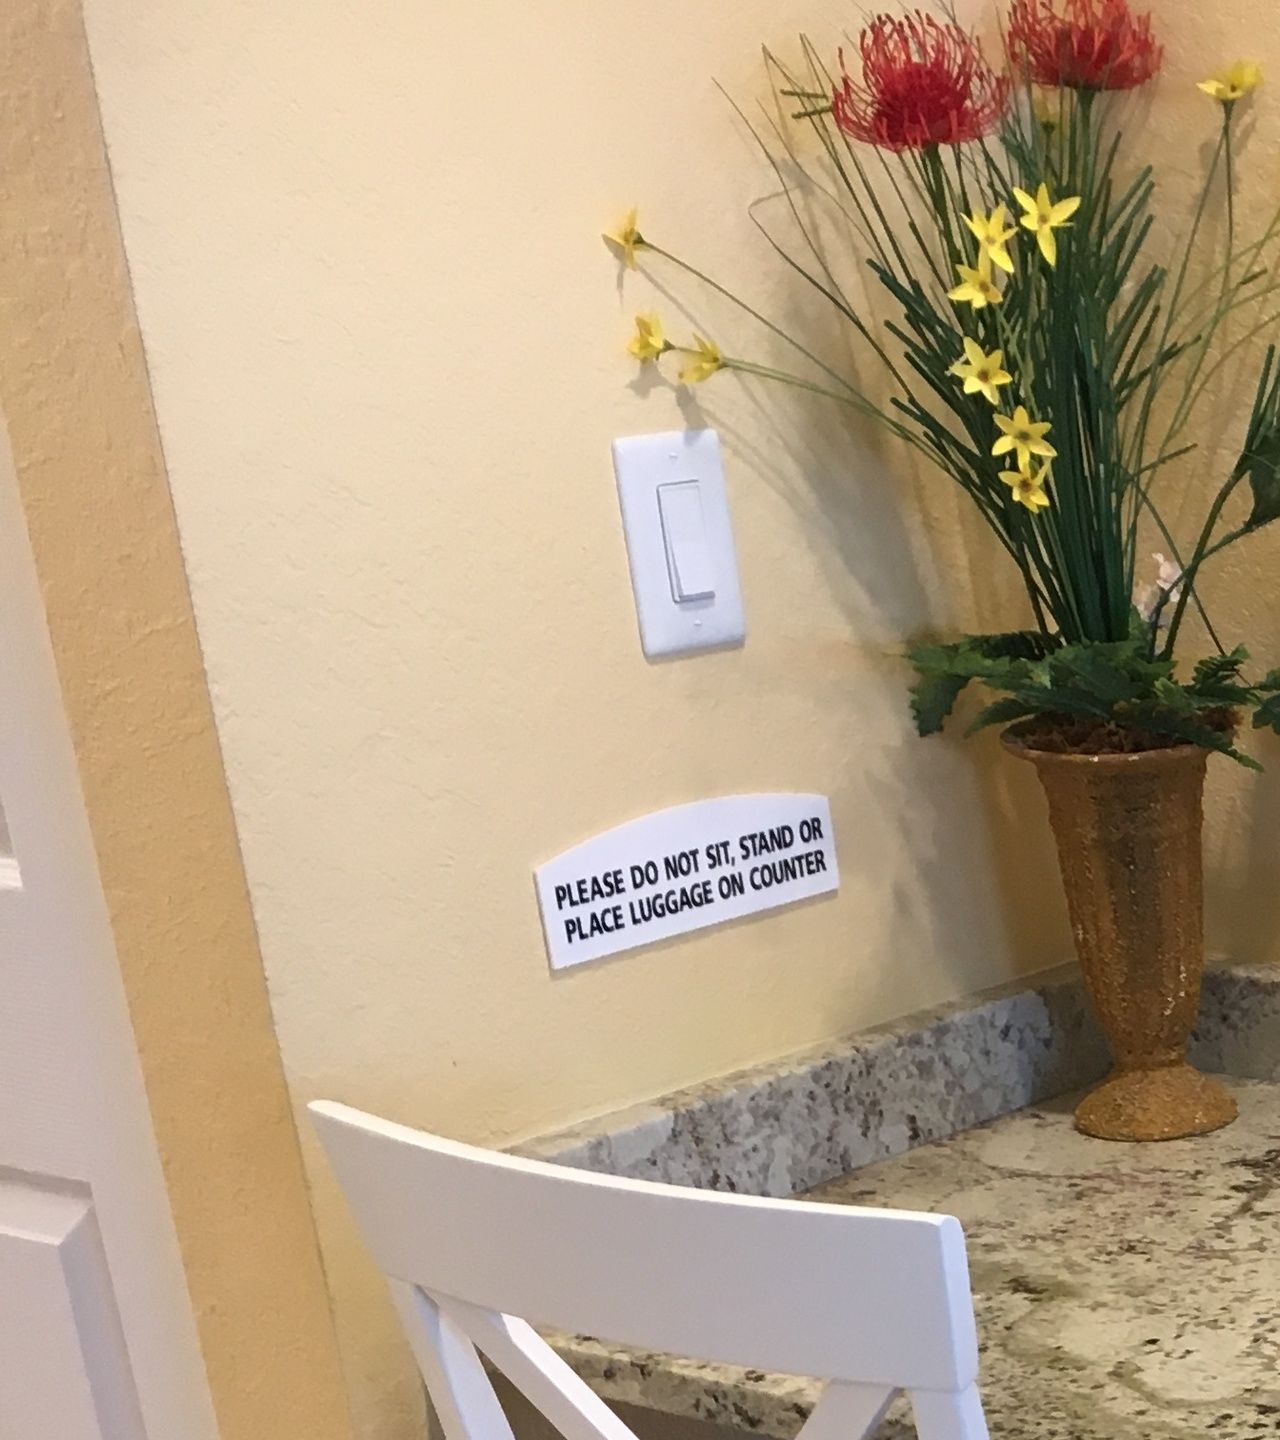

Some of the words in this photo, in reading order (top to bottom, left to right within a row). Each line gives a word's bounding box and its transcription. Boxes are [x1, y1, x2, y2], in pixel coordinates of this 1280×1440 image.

[555, 869, 626, 910] PLEASE
[631, 860, 658, 889] DO
[664, 848, 700, 883] NOT
[707, 841, 736, 869] SIT,
[739, 825, 795, 860] STAND
[799, 817, 824, 843] OR
[564, 905, 625, 943] PLACE
[629, 881, 714, 925] LUGGAGE
[718, 872, 745, 899] ON
[749, 850, 828, 890] COUNTER
